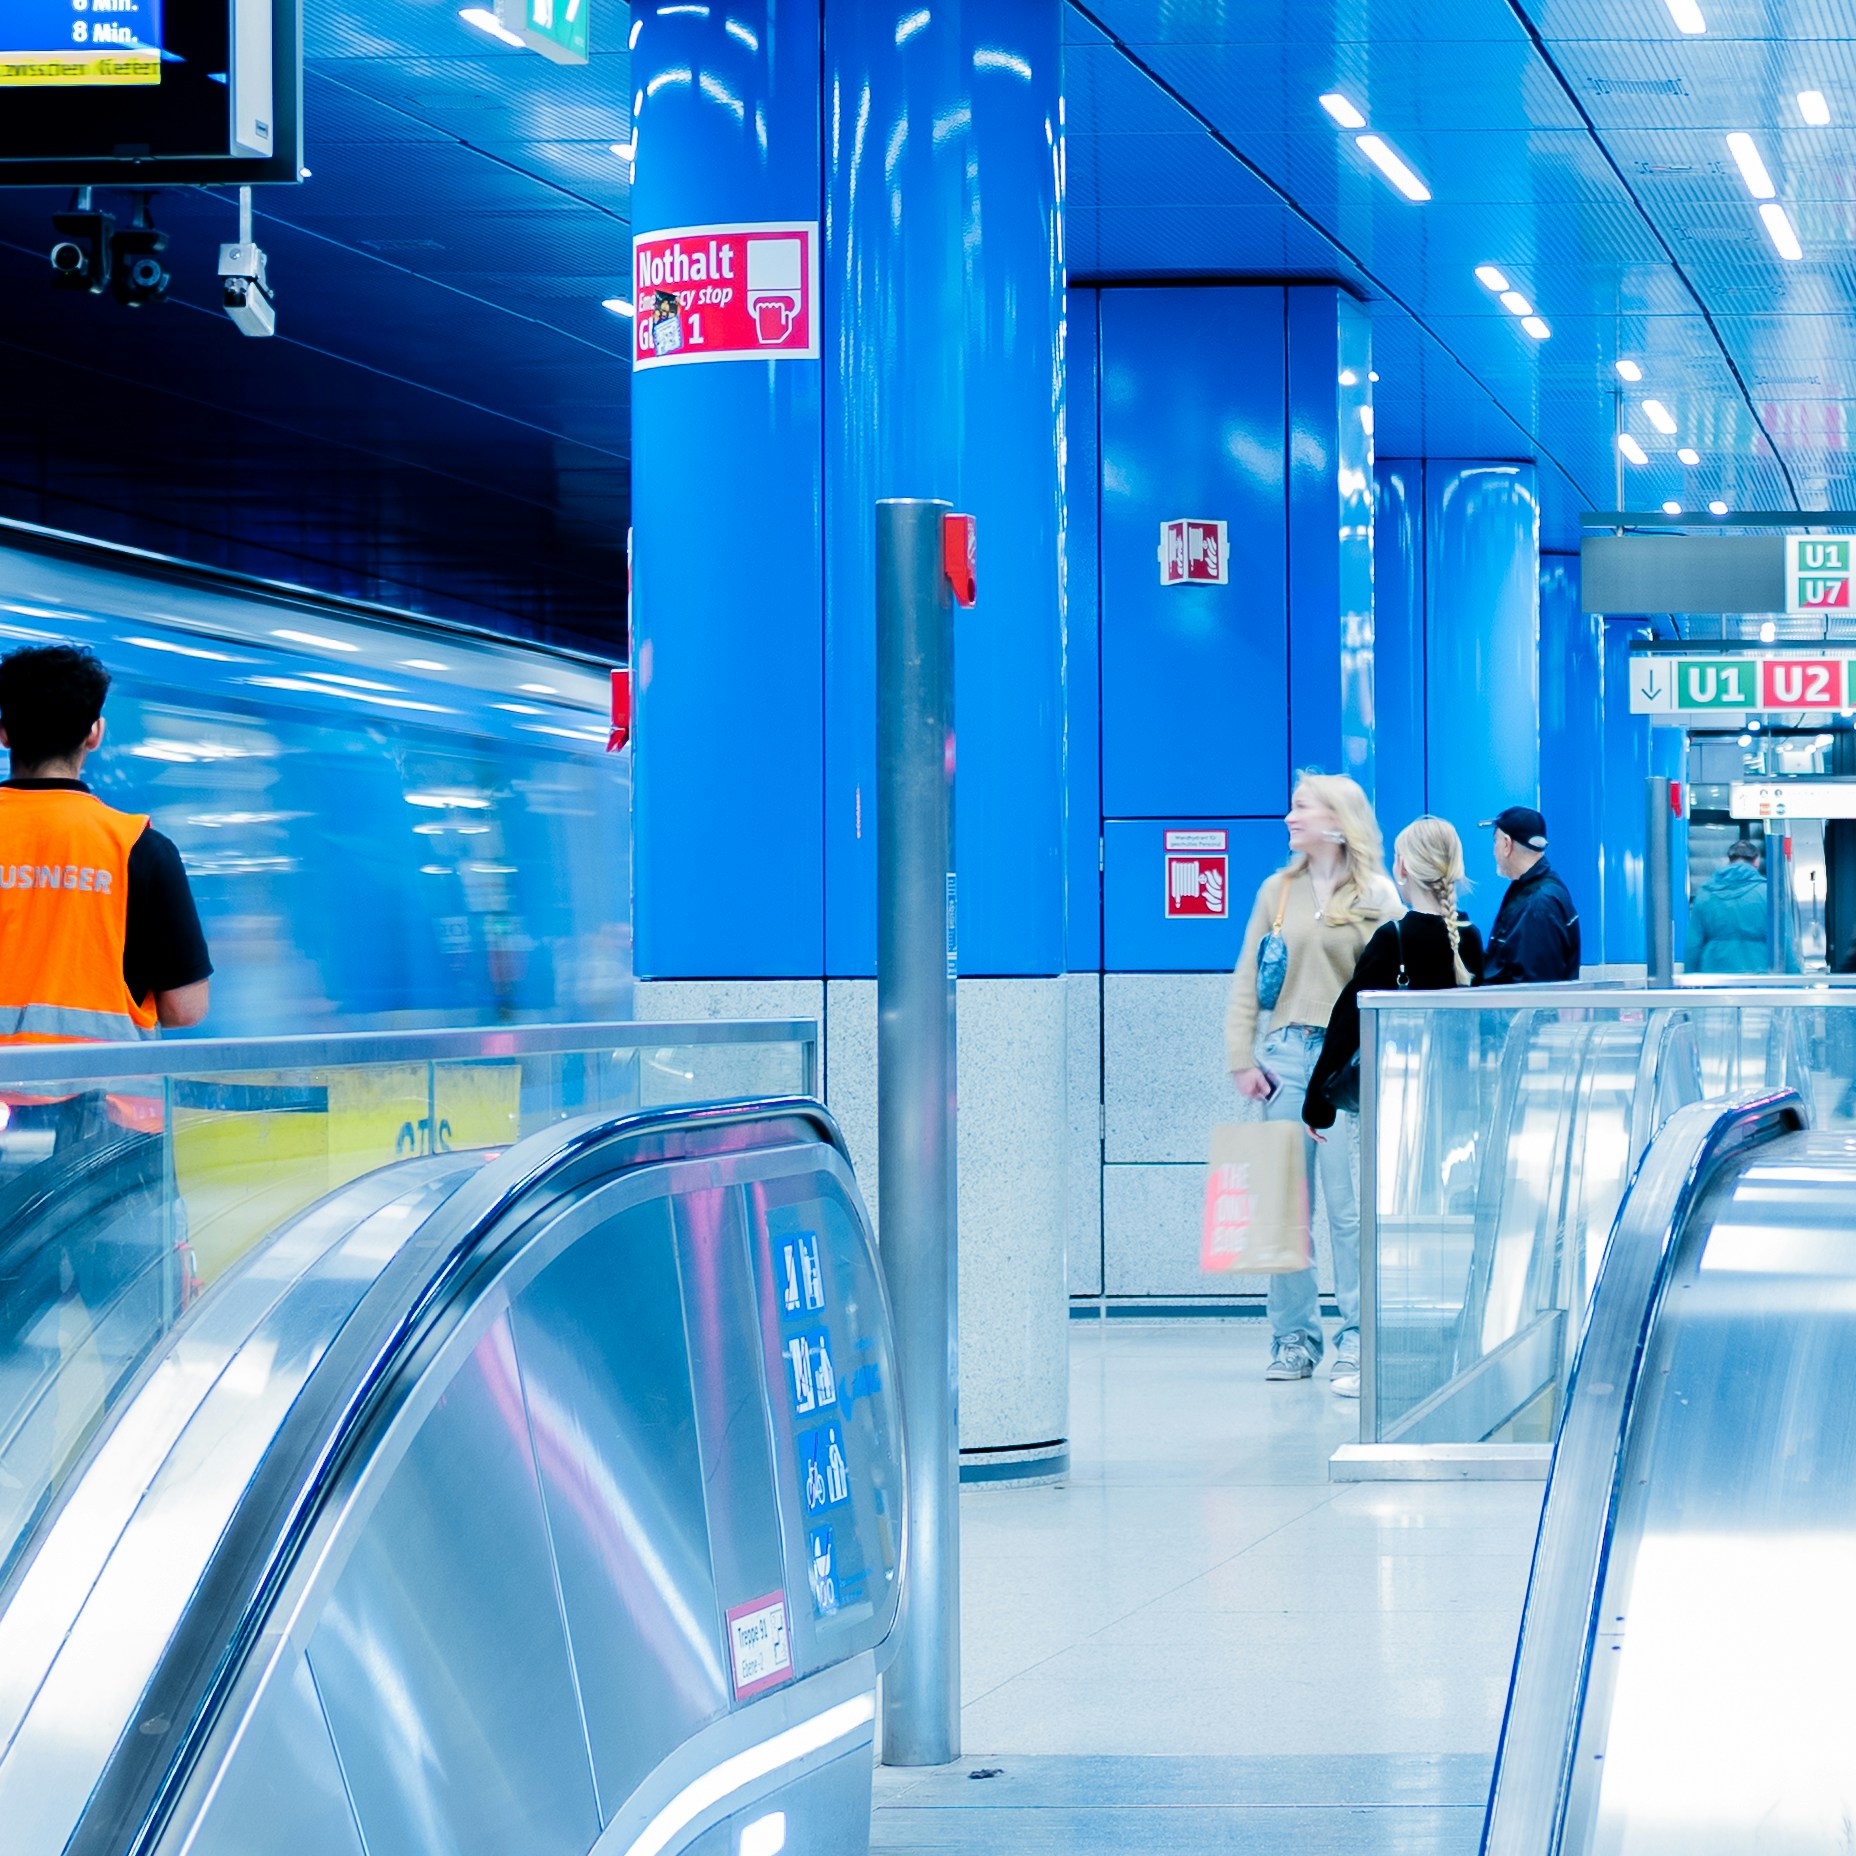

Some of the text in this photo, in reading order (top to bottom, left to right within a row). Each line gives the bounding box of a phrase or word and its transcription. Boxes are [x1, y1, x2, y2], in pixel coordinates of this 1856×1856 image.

[72, 20, 139, 44] 8 Min.
[639, 240, 734, 289] Nothalt
[698, 285, 733, 309] stop
[688, 313, 705, 345] 1
[1805, 544, 1842, 568] U1
[1806, 580, 1842, 604] U7
[1688, 666, 1746, 703] U1
[1773, 666, 1830, 703] U2
